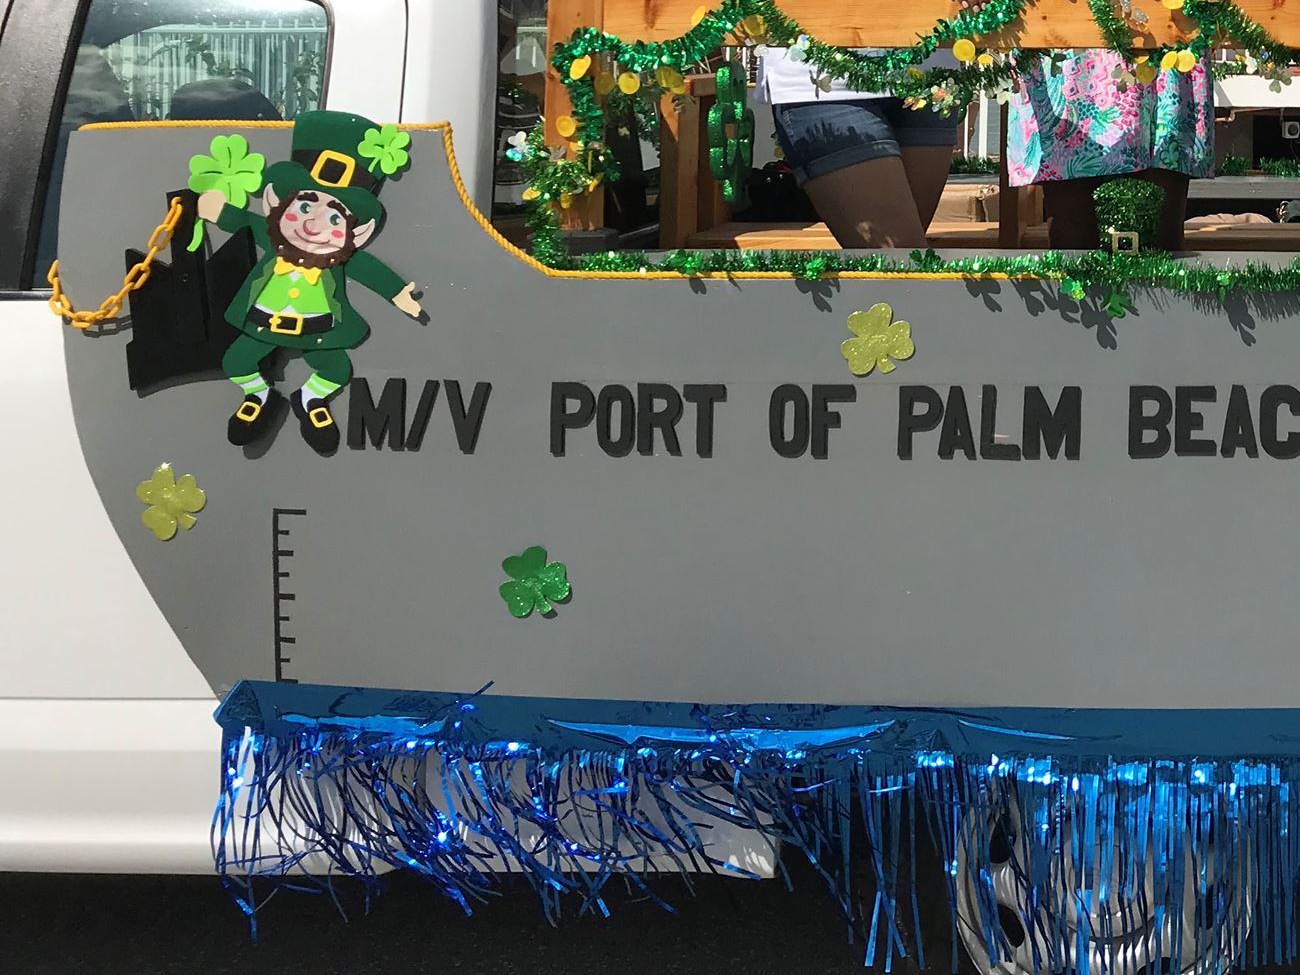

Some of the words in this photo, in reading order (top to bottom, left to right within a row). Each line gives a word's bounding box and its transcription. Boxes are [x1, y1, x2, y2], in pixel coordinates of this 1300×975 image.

[346, 378, 493, 455] M/V
[549, 381, 728, 459] PORT
[768, 383, 857, 460] OF
[896, 384, 1083, 461] PALM
